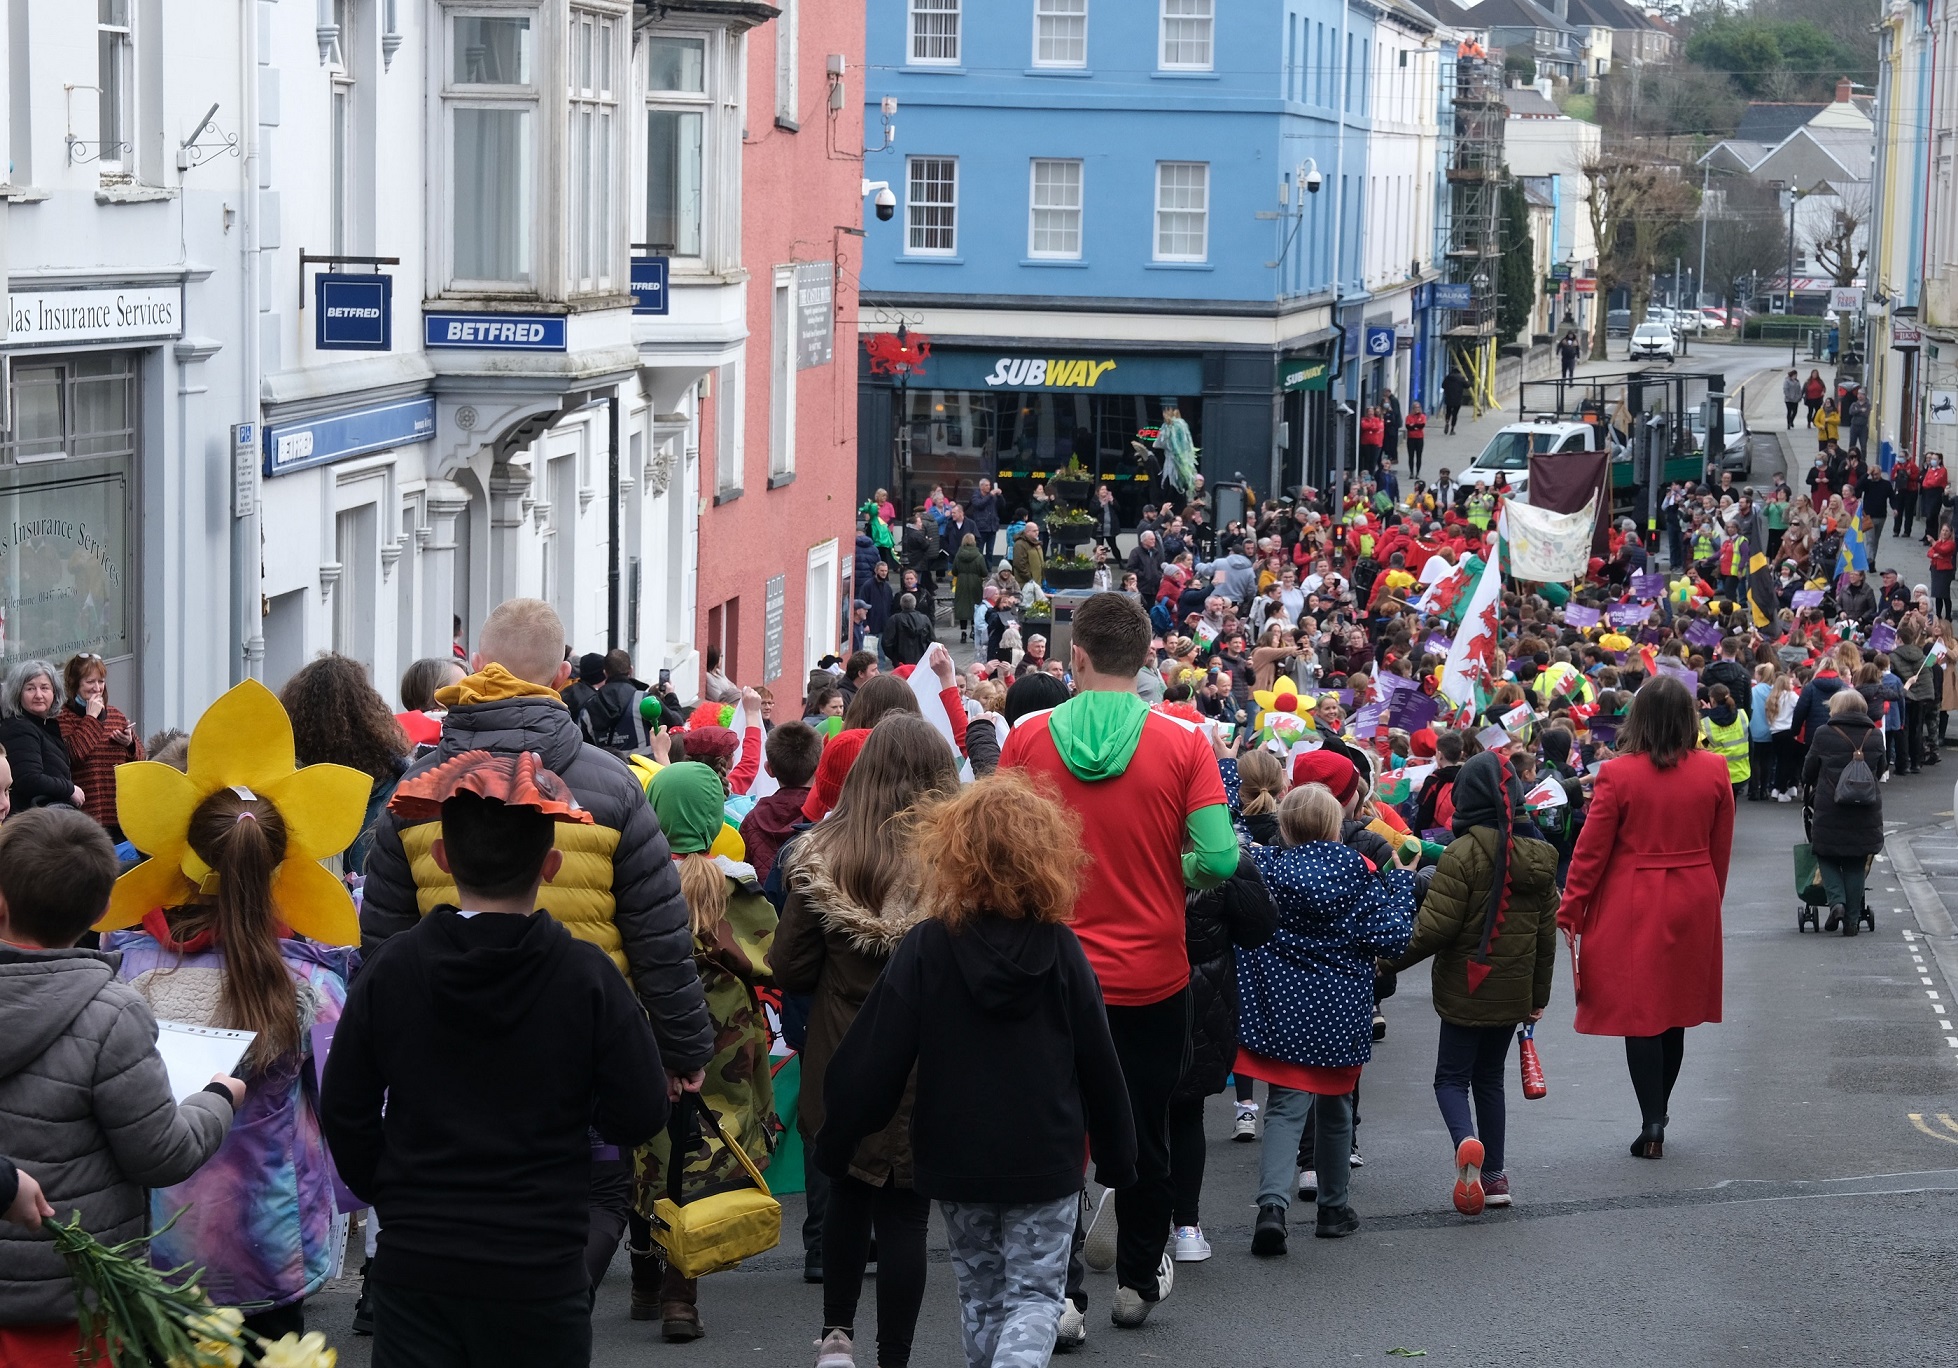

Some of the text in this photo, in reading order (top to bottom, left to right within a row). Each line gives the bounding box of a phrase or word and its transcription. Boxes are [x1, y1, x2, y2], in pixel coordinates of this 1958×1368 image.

[630, 282, 660, 290] TFRED
[1436, 292, 1468, 300] HALIFAX
[8, 296, 172, 332] las Insurance Services
[327, 307, 380, 318] BETFRED
[447, 322, 544, 342] BETFRED
[984, 358, 1117, 387] SUBWAY
[1284, 364, 1326, 386] SUBWAY
[1138, 429, 1160, 438] OPE
[1134, 474, 1149, 482] SUB
[13, 518, 73, 546] Insurance
[78, 522, 120, 588] Services
